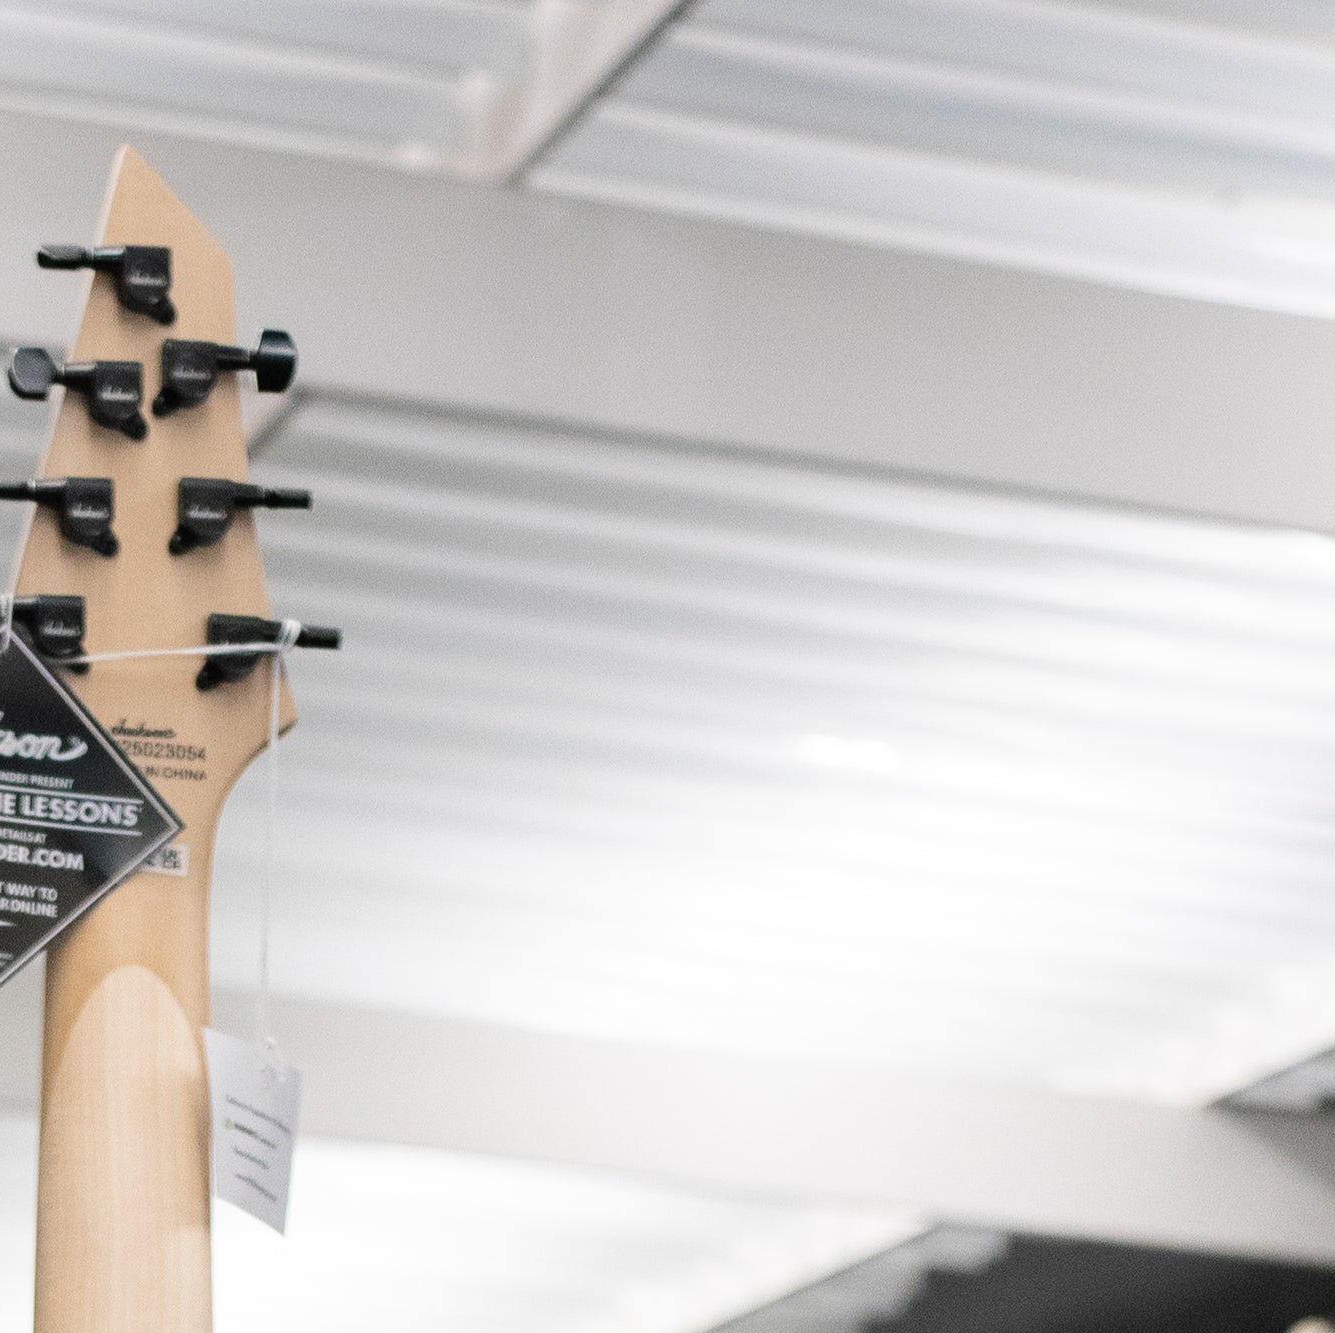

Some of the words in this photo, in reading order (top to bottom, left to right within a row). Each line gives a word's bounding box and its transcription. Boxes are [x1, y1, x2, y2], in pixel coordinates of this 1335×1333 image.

[30, 773, 74, 789] PRESENT
[21, 796, 139, 828] LESSONS
[5, 881, 38, 899] WAY
[38, 887, 58, 901] TO
[10, 899, 59, 918] ONLINE
